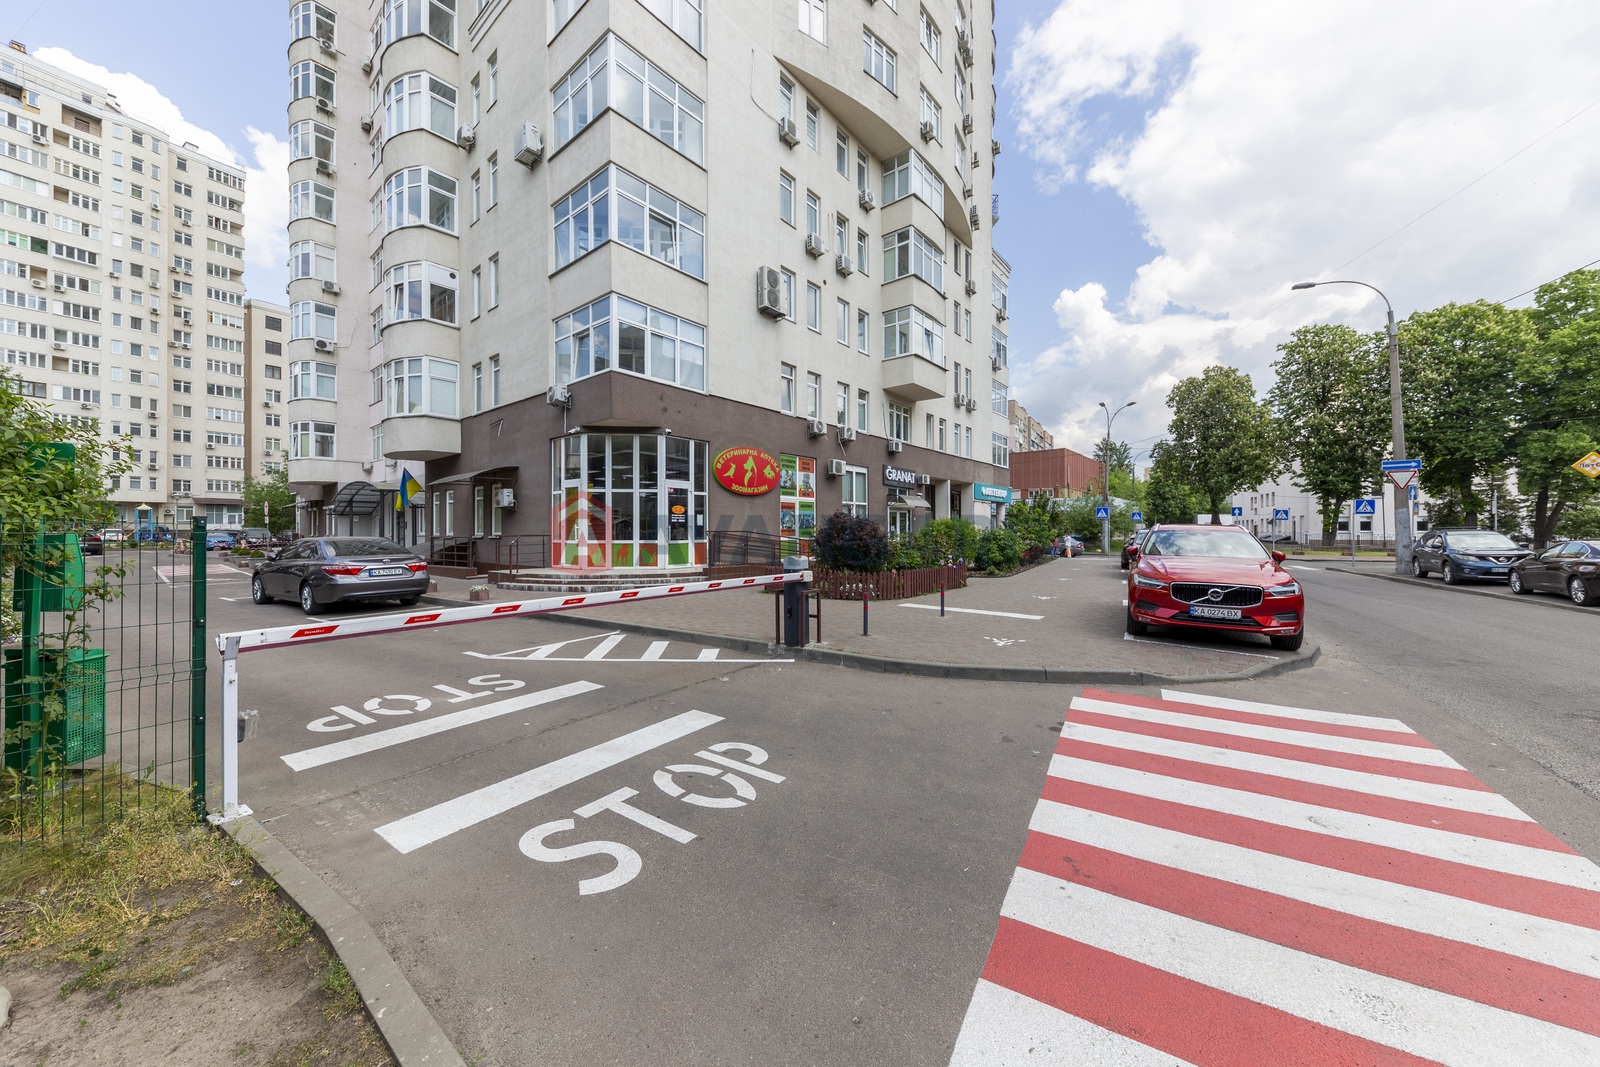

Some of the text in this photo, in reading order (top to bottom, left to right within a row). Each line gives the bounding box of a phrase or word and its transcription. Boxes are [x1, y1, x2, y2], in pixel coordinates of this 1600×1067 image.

[716, 449, 780, 473] ВЕТЕРИНАРНА АПТЕКА
[886, 468, 916, 484] GRANAT
[731, 483, 769, 493] ЗООМАГАЗИН
[1194, 607, 1205, 615] KA
[1207, 608, 1225, 616] 0274
[306, 673, 526, 733] STOP
[518, 742, 786, 896] STOP
